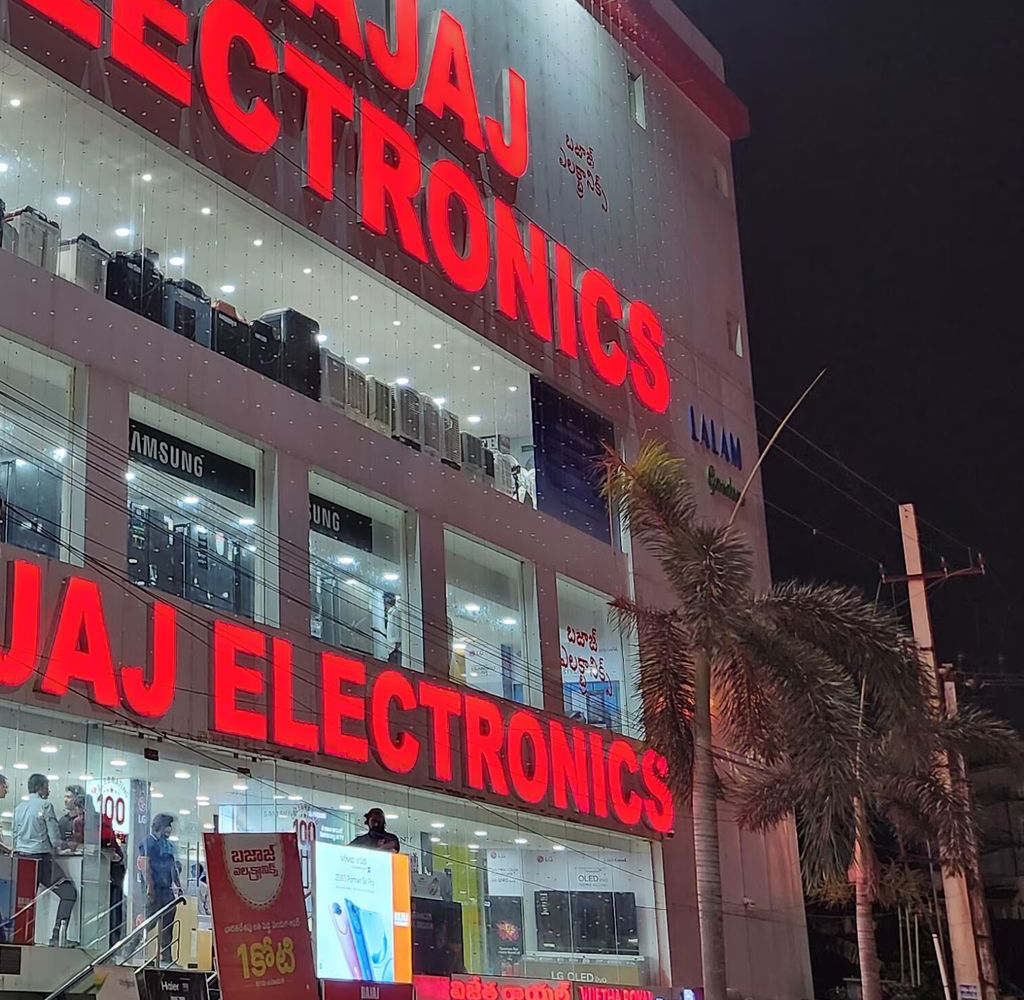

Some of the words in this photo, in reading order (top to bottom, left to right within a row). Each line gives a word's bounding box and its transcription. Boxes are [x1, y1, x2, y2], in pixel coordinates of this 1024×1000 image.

[130, 430, 204, 478] AMSUNG
[212, 620, 675, 834] ELECTRONICS
[231, 843, 276, 863] బజాజ్
[578, 874, 599, 883] OLED
[551, 971, 564, 981] LG
[567, 972, 595, 983] OLED
[160, 980, 180, 991] Haier
